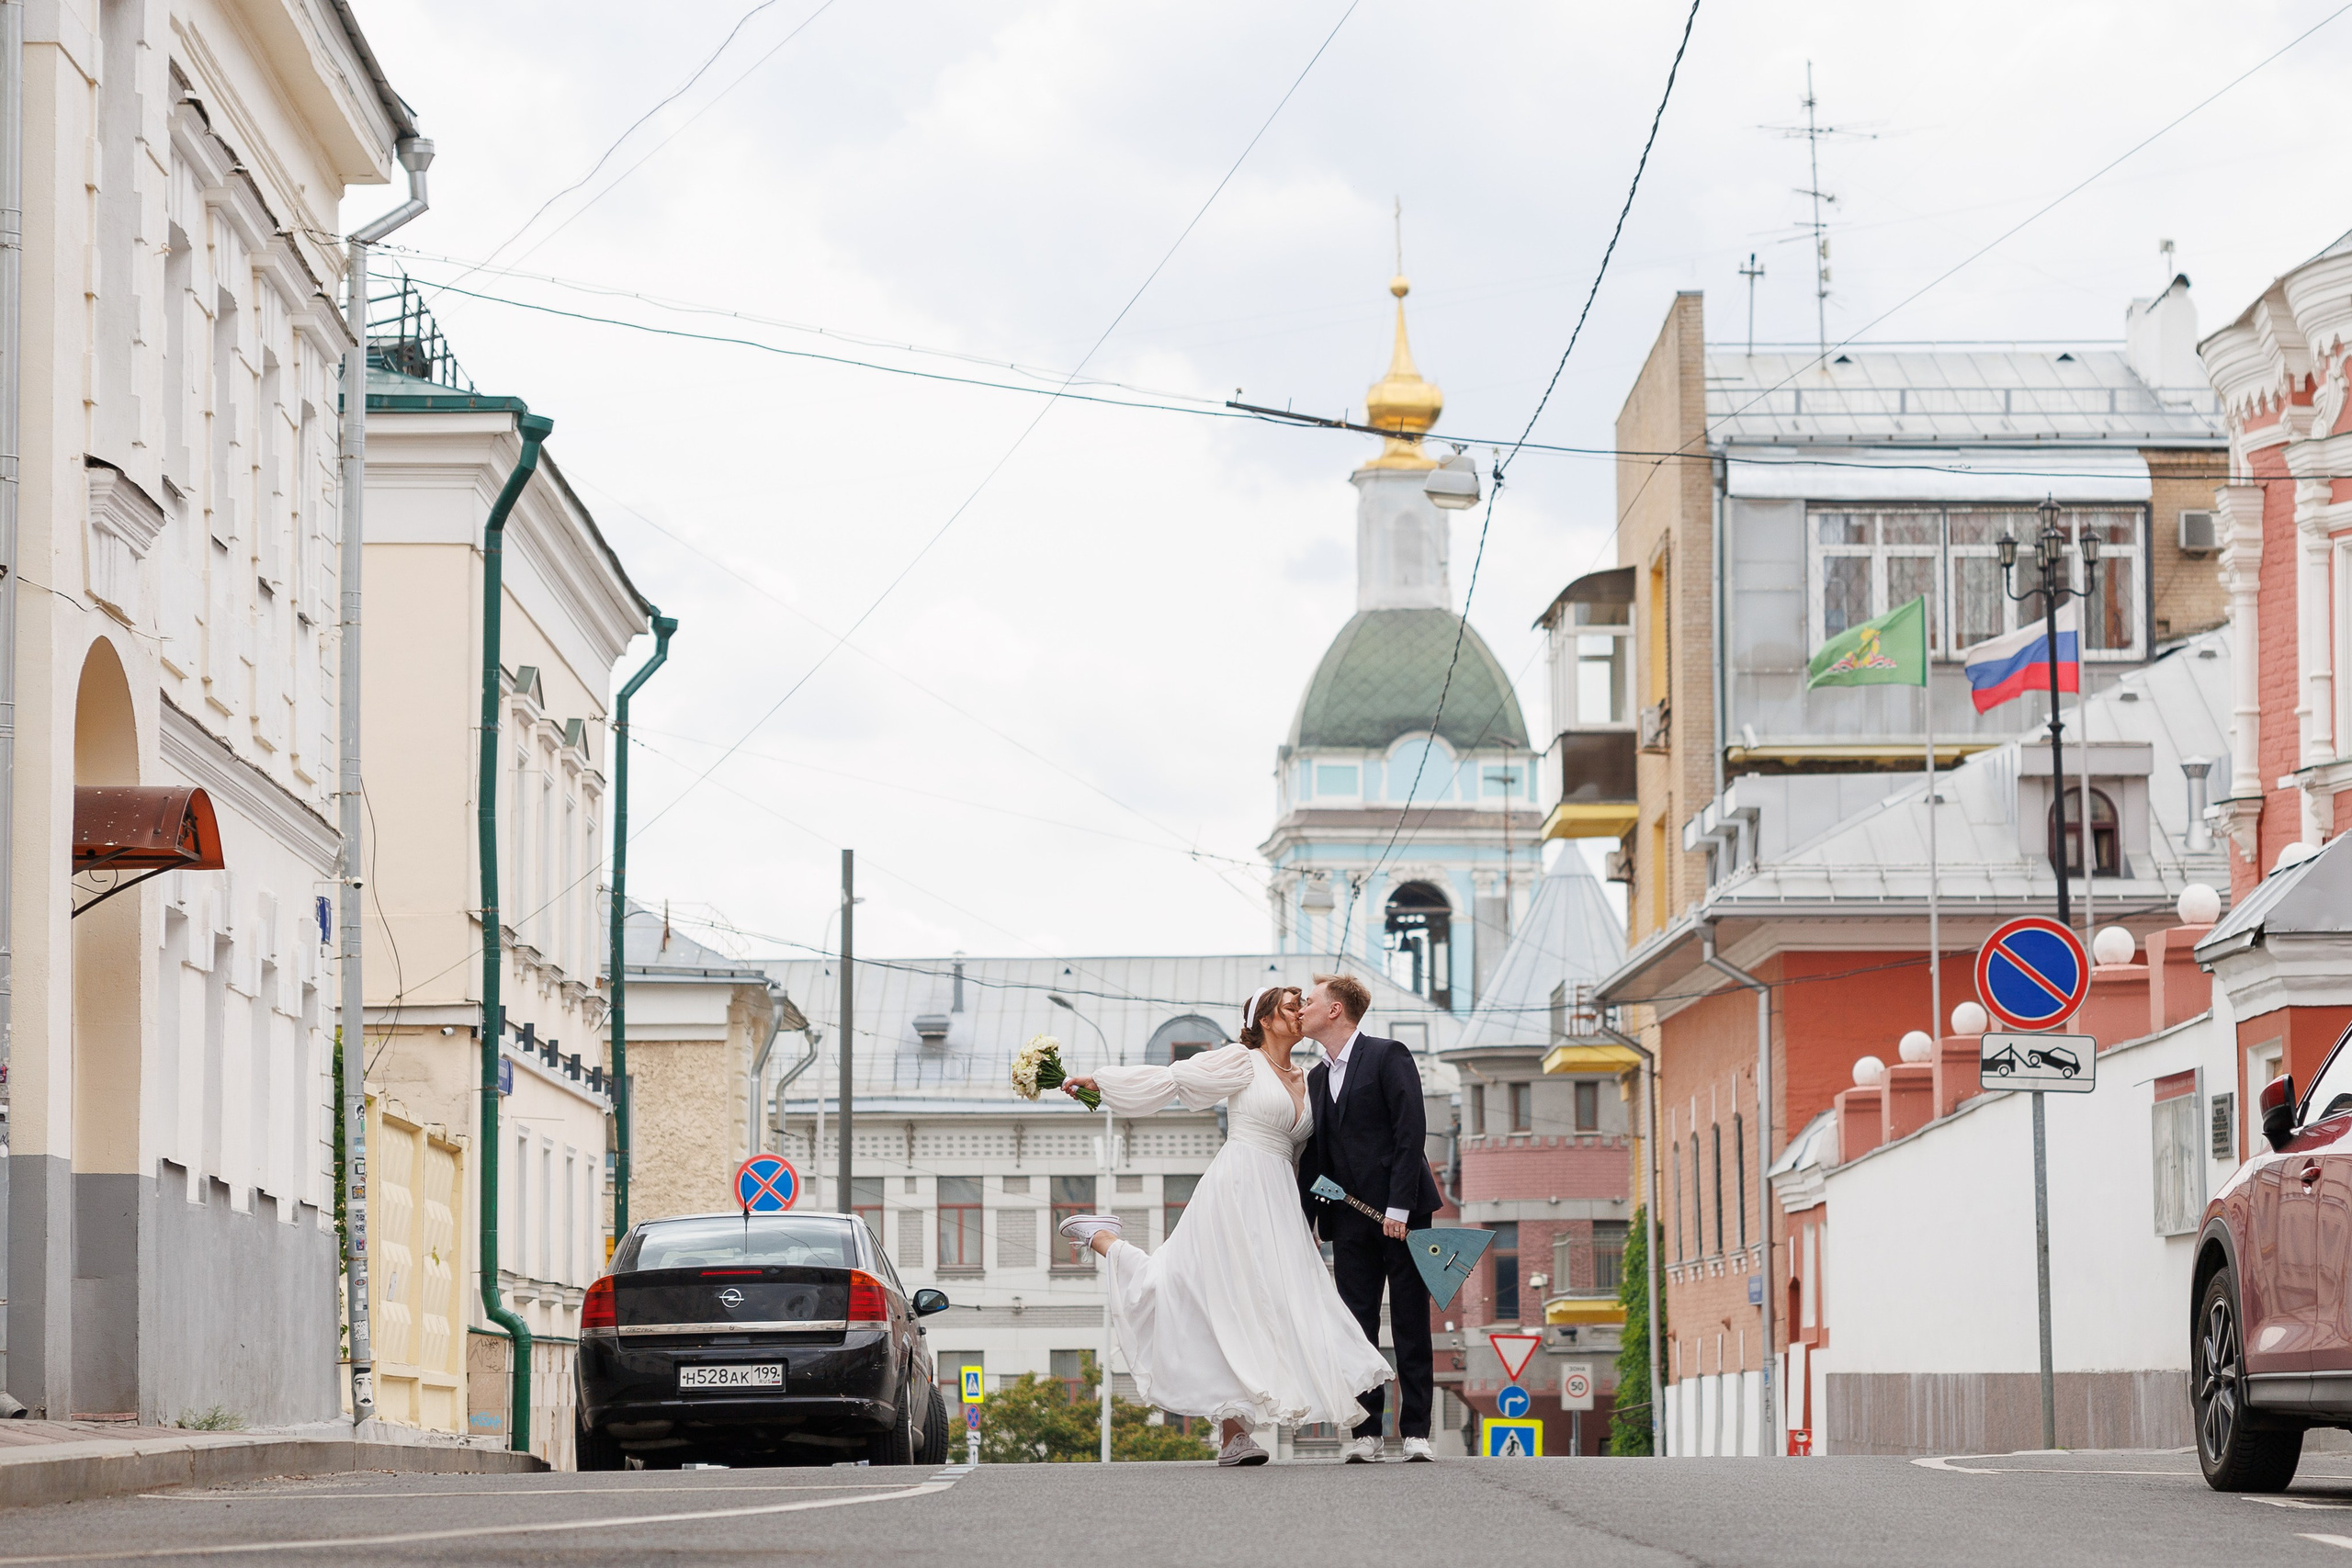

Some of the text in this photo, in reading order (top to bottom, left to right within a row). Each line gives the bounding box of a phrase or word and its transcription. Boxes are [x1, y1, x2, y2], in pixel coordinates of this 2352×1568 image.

[686, 1367, 778, 1384] Н528АК 199
[1571, 1381, 1584, 1391] 50
